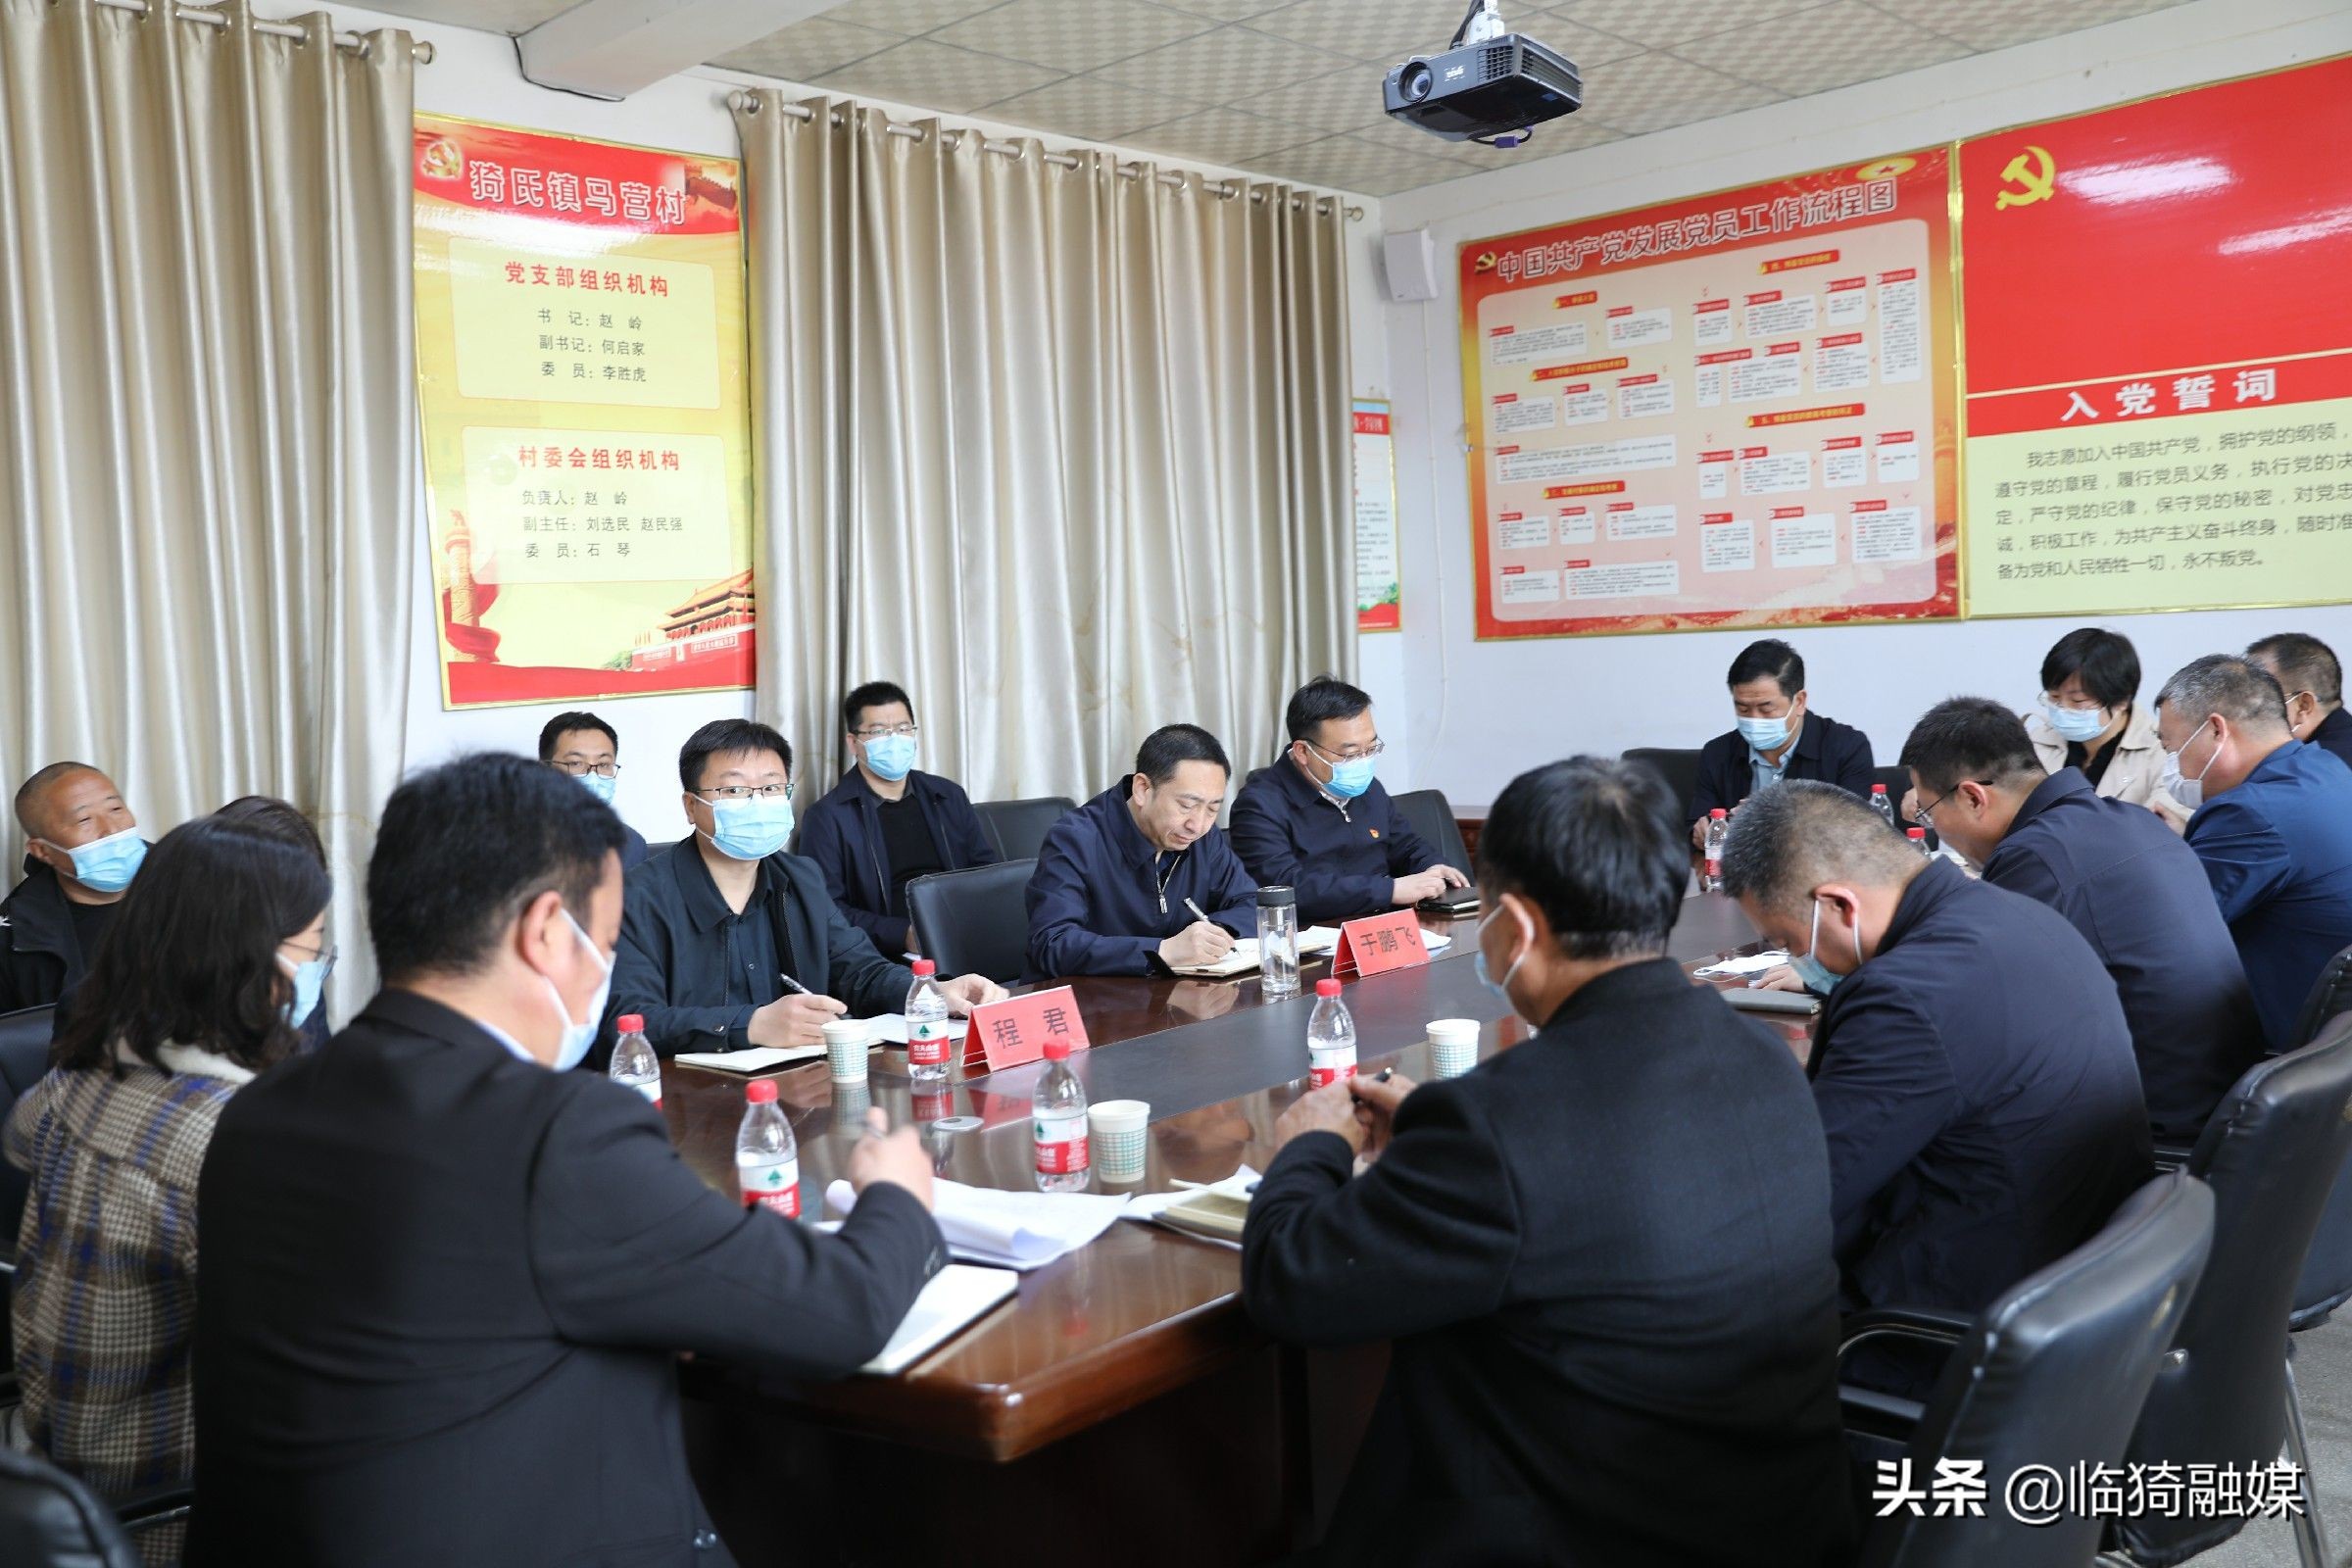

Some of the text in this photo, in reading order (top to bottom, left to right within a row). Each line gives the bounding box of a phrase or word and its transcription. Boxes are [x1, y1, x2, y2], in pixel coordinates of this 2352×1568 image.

[469, 160, 686, 225] 猗氏镇马营村
[1497, 177, 1898, 282] 中国共产党发展党员工作流程图
[505, 261, 668, 298] 党支部组织机构
[2060, 368, 2278, 422] 入党誓词
[518, 446, 680, 471] 村委会组织机构
[1360, 925, 1416, 956] 于鹏飞
